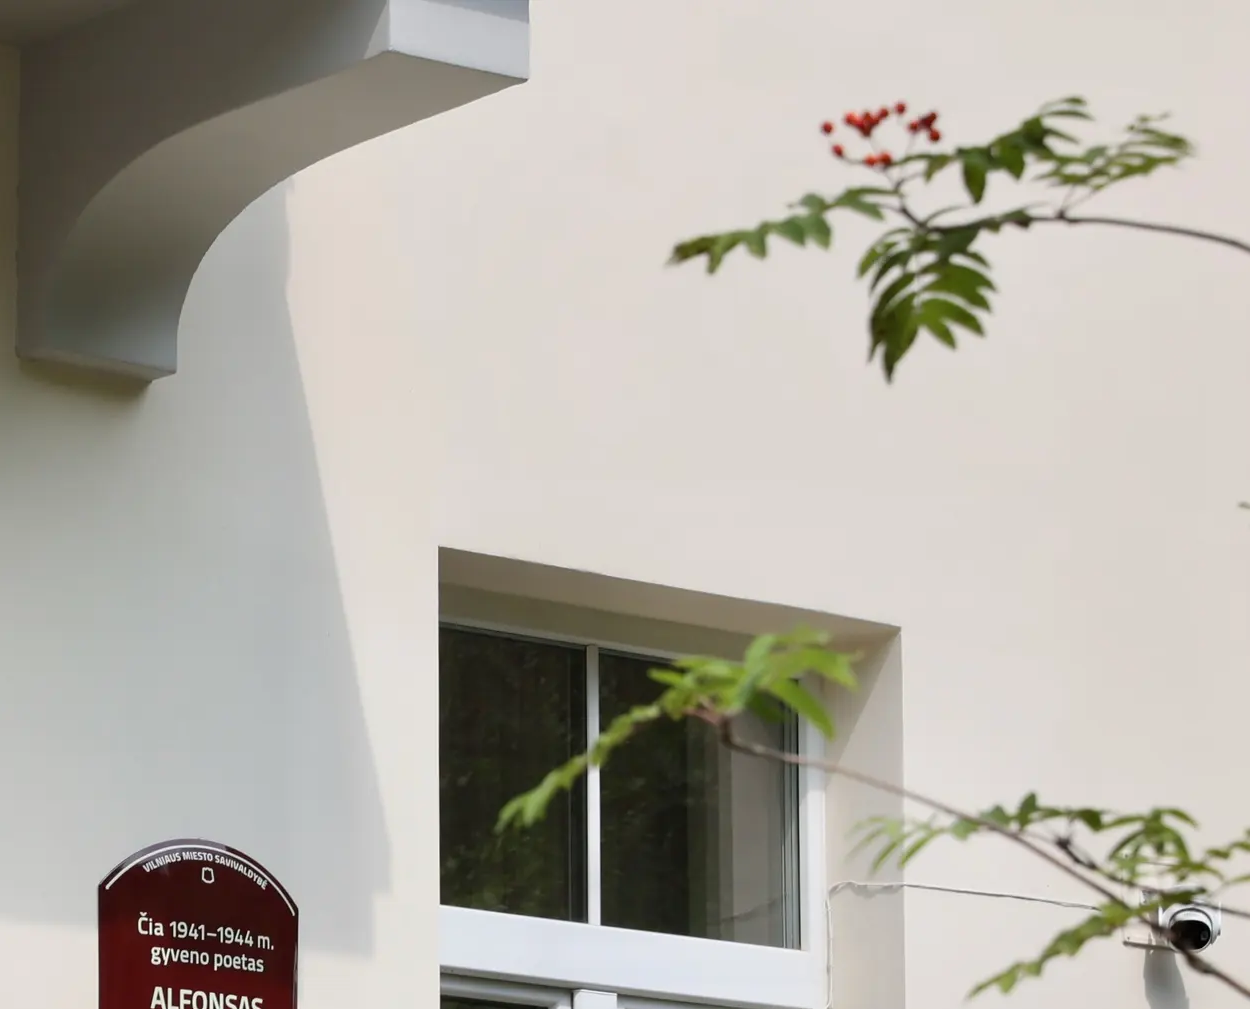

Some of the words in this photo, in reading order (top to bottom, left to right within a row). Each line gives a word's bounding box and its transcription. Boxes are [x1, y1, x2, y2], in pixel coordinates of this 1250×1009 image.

[142, 852, 182, 873] VILNIAUS
[182, 851, 213, 862] MIESTO
[215, 854, 268, 890] SAVIVALDYBĖ
[137, 911, 164, 937] Čia
[257, 935, 274, 950] m.
[150, 946, 209, 966] gyveno
[213, 953, 264, 972] poetas
